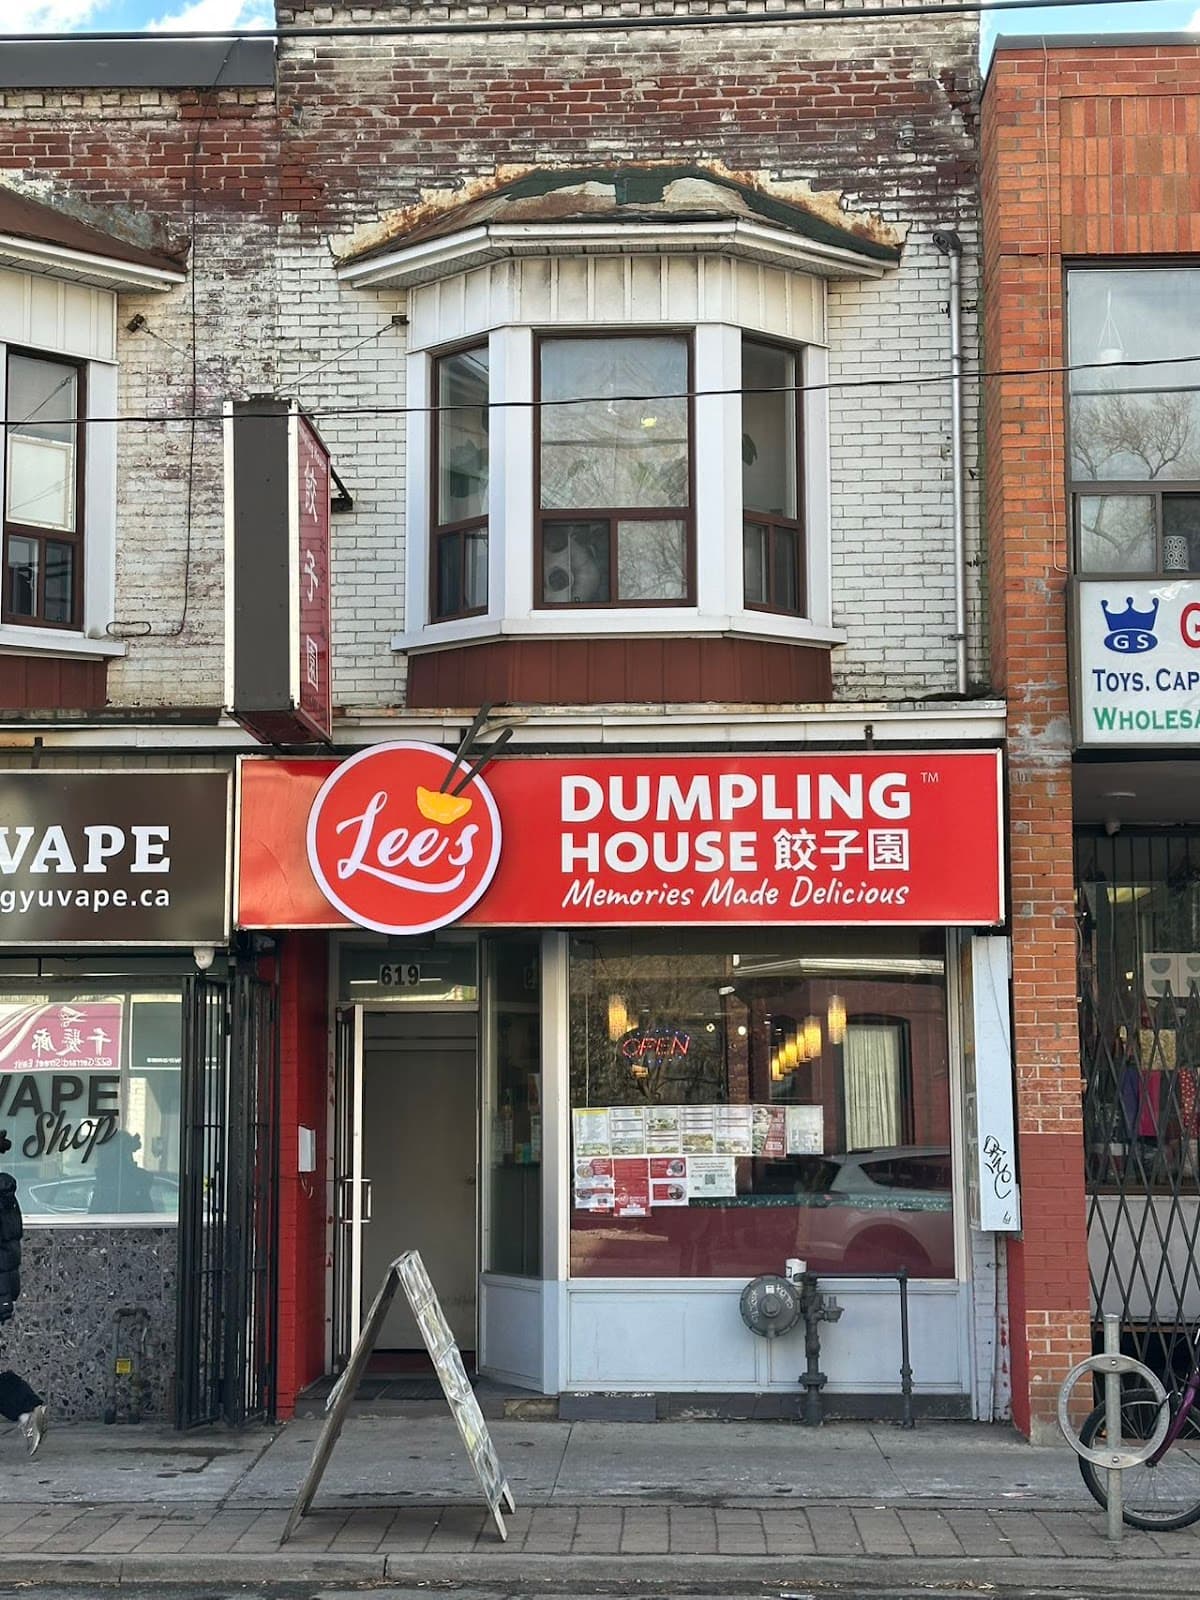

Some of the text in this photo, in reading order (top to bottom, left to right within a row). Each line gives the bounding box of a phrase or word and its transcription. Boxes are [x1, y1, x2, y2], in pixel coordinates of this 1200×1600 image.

[560, 771, 939, 822] DUMPLING TM
[0, 825, 171, 874] VAPE
[560, 831, 758, 874] HOUSE
[773, 827, 910, 873] 餃子園
[0, 889, 170, 913] gyuvape.ca
[562, 875, 910, 908] Memories Made Delicious
[380, 964, 419, 986] 619
[622, 1036, 690, 1058] OPEN
[22, 1109, 118, 1164] Shop
